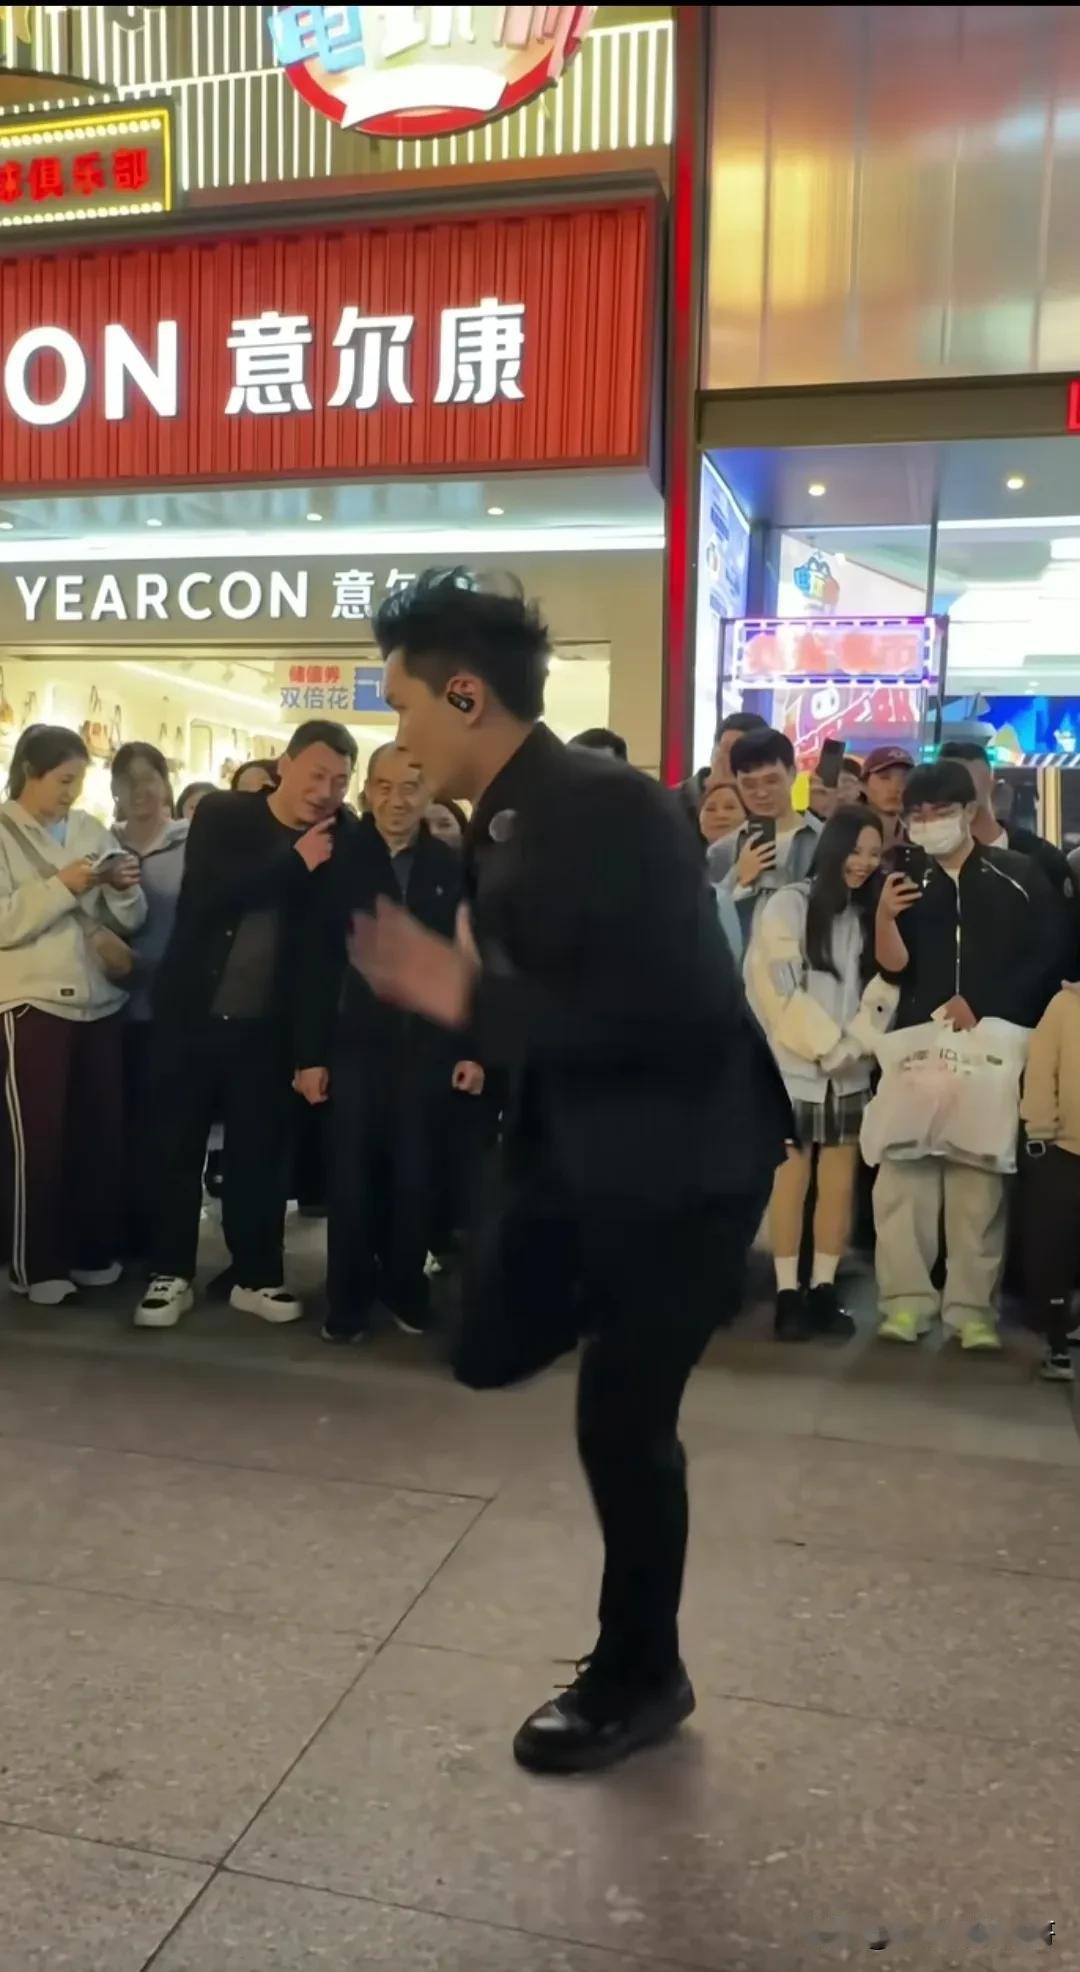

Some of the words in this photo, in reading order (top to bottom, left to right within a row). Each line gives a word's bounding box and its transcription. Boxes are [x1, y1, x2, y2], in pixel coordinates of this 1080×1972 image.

[4, 320, 178, 425] ON
[224, 298, 526, 415] 意尔康
[15, 571, 309, 622] YEARCON
[280, 686, 349, 711] 双倍花
